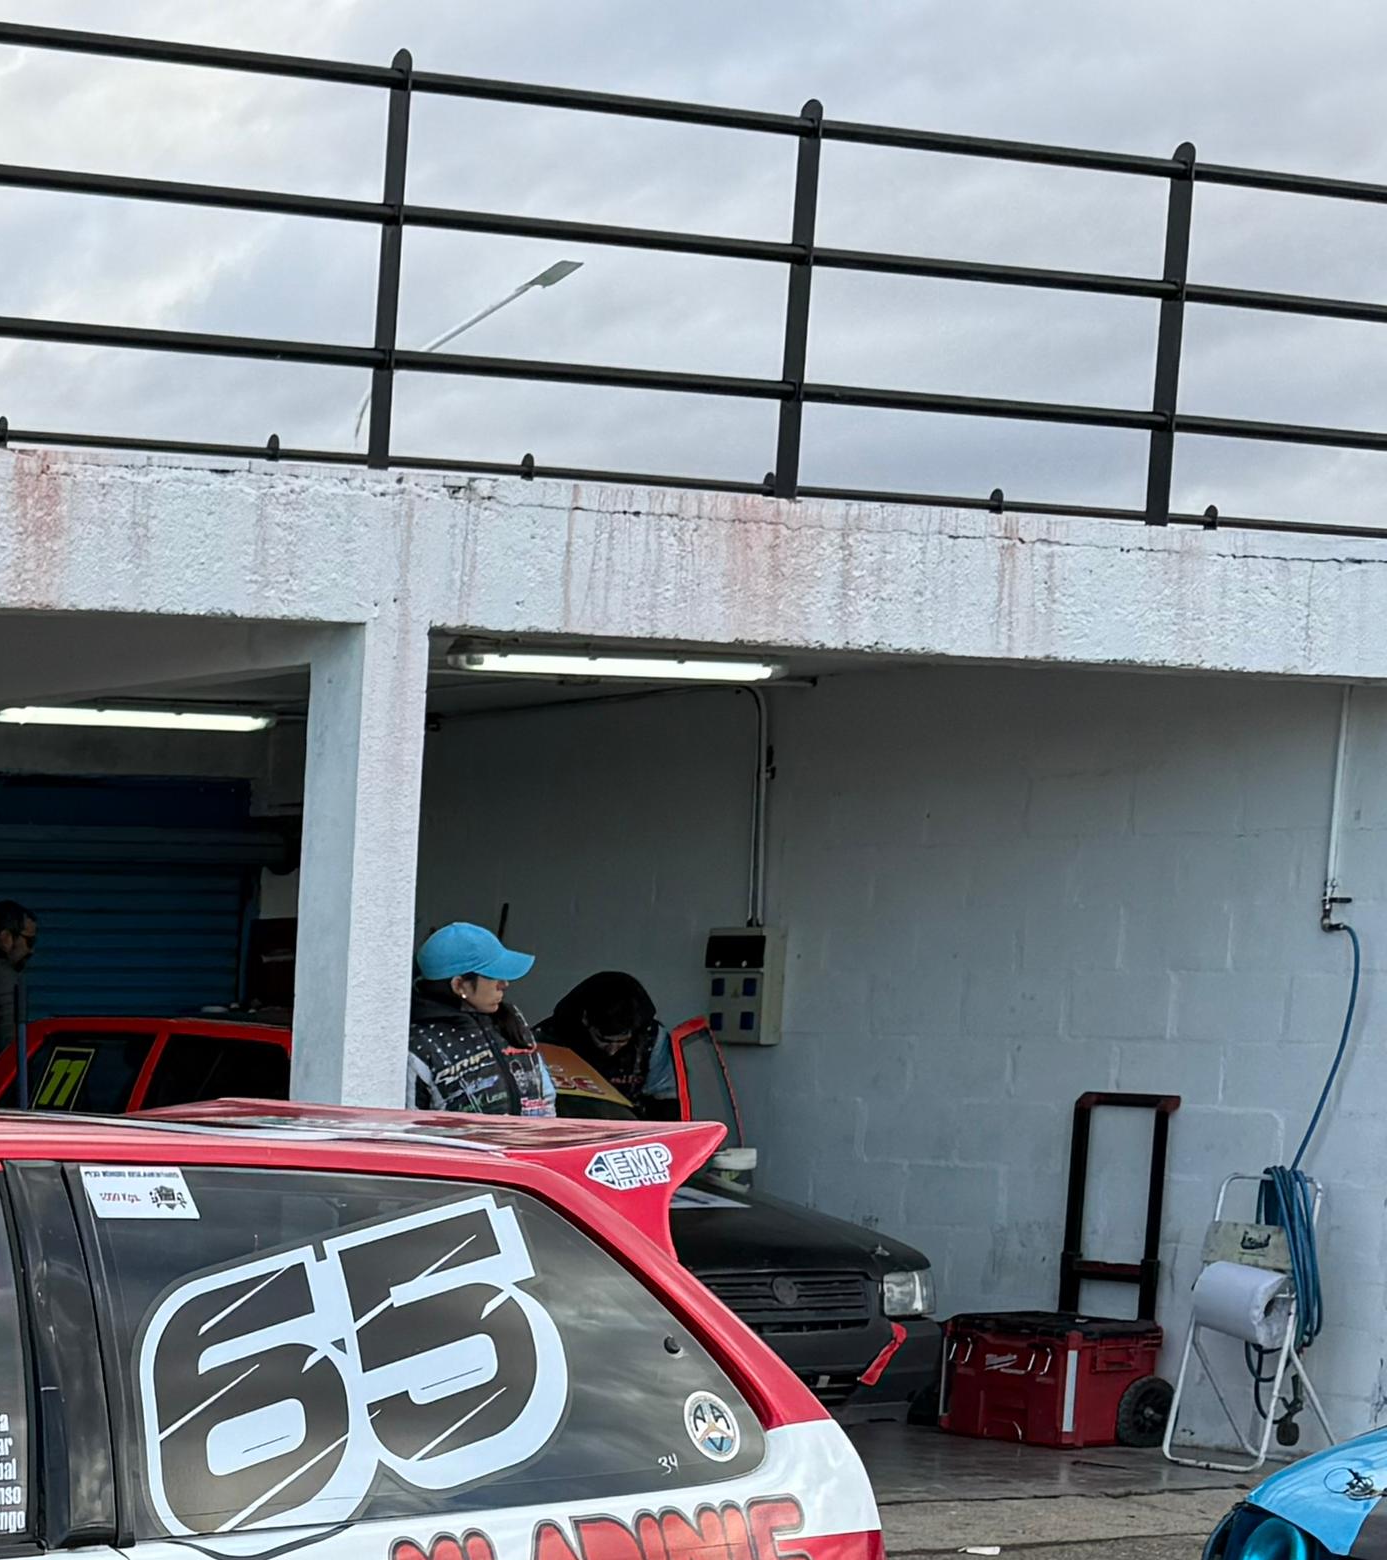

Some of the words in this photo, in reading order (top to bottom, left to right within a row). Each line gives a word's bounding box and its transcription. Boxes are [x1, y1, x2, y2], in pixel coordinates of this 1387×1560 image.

[38, 1059, 87, 1106] 11
[605, 1145, 670, 1181] EMP
[145, 1198, 557, 1545] 65
